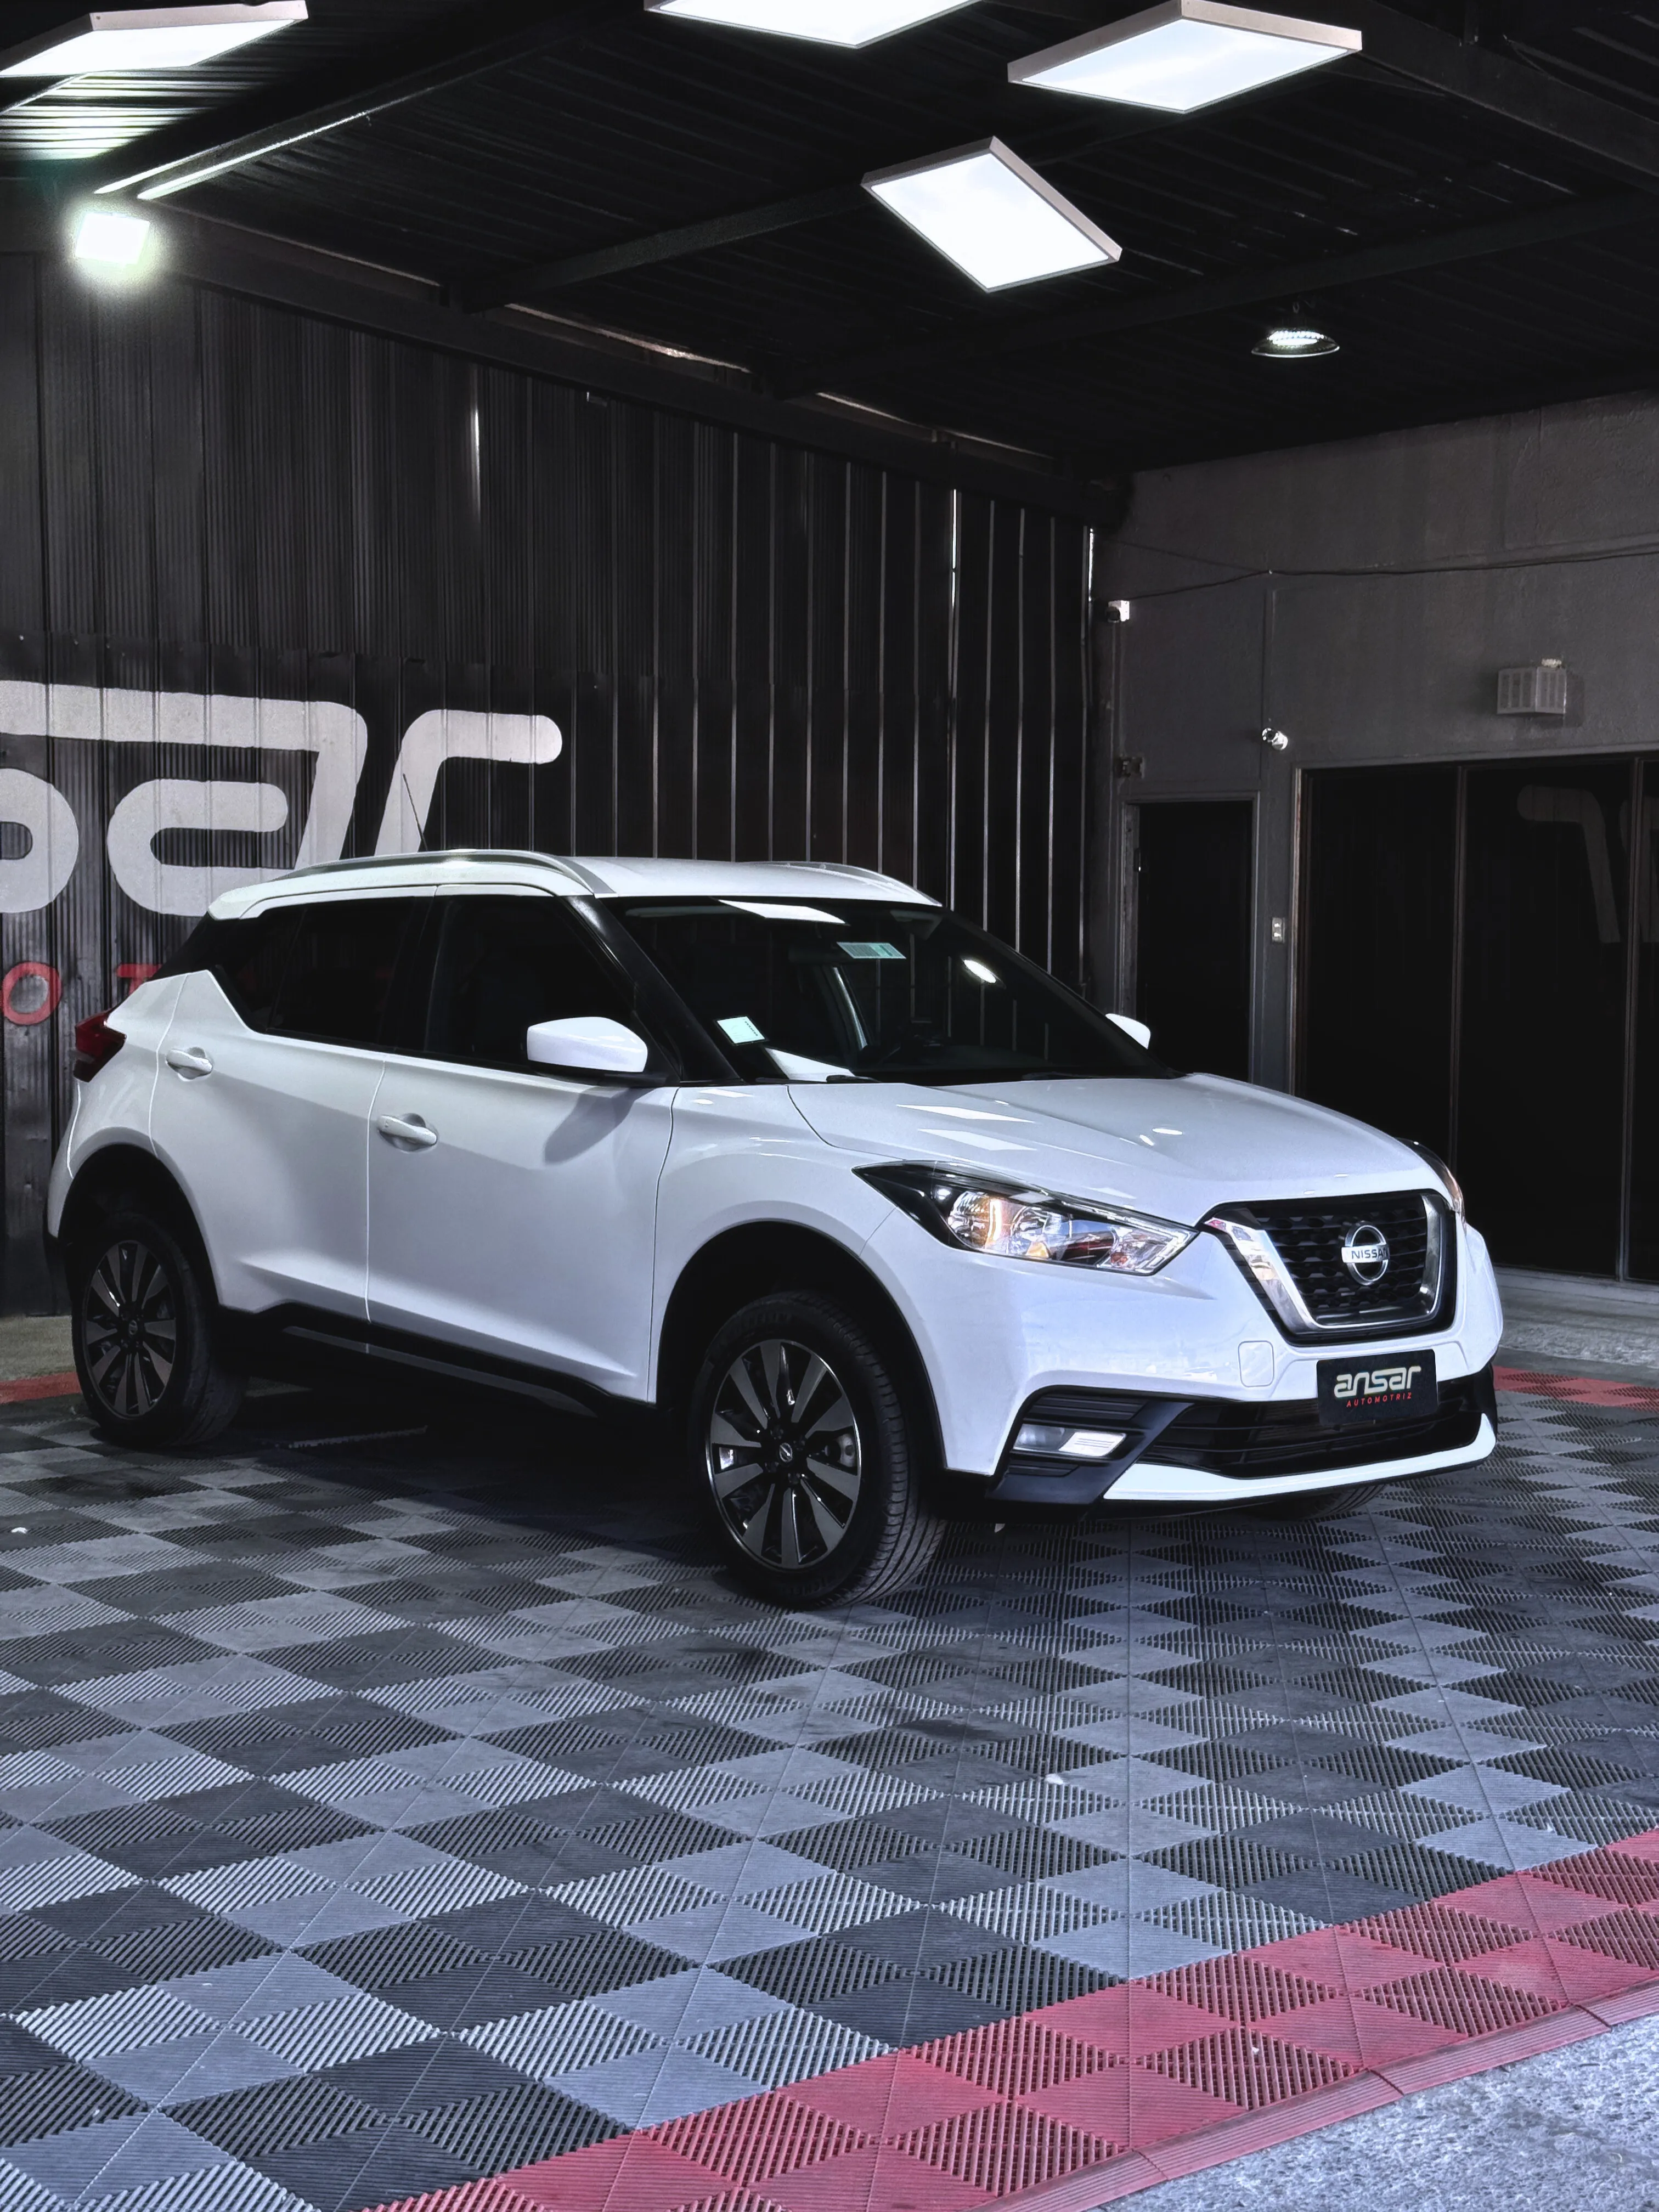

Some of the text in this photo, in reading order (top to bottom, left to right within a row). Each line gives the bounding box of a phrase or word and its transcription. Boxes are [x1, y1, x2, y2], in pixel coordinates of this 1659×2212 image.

[1351, 1246, 1388, 1260] NISSAN
[1334, 1365, 1422, 1398] ansar
[1346, 1392, 1412, 1408] AUTOMOTRIZ
